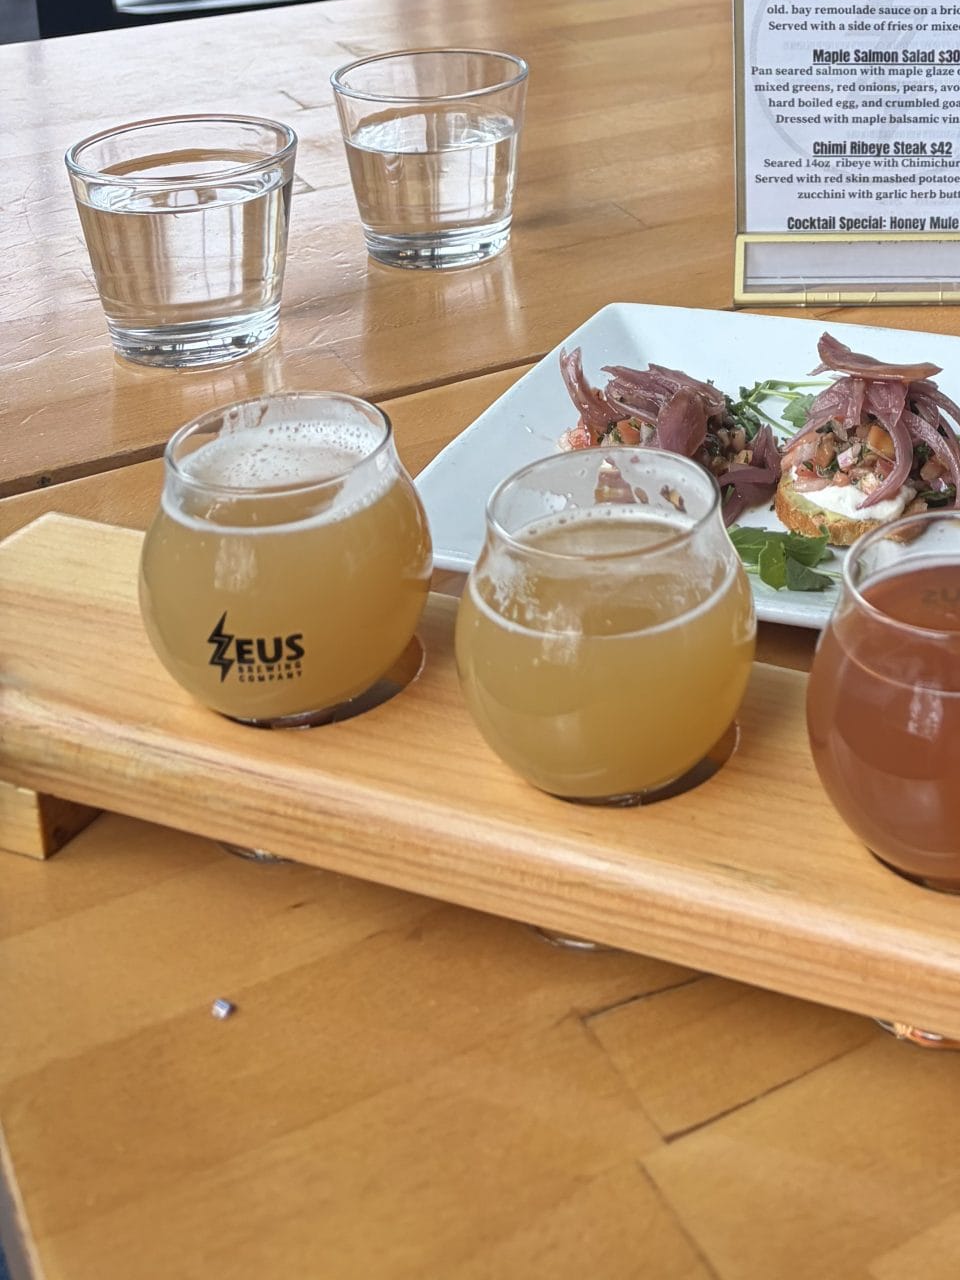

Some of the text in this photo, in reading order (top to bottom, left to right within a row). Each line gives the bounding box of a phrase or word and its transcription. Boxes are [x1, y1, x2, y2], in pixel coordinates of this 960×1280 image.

[766, 3, 789, 15] old.
[791, 3, 813, 18] bay
[814, 4, 877, 16] remoulade
[877, 6, 912, 16] sauce
[912, 7, 929, 16] on
[930, 7, 938, 16] a
[768, 20, 809, 32] Served
[809, 20, 837, 32] with
[838, 23, 846, 32] a
[847, 19, 872, 32] side
[872, 20, 887, 32] of
[887, 20, 914, 32] fries
[915, 23, 930, 32] or
[812, 48, 852, 65] Maple
[853, 48, 900, 64] Salmon
[901, 48, 936, 64] Salad
[751, 65, 774, 77] Pan
[775, 65, 814, 77] seared
[815, 65, 858, 77] salmon
[859, 65, 886, 77] with
[887, 65, 924, 79] maple
[925, 65, 956, 79] glaze
[754, 81, 791, 93] mixed
[791, 83, 835, 95] greens,
[836, 81, 857, 93] red
[857, 81, 901, 94] onions,
[902, 84, 939, 95] pears,
[767, 97, 796, 109] hard
[797, 97, 834, 109] boiled
[835, 99, 860, 111] egg,
[861, 97, 884, 109] and
[884, 97, 941, 109] crumbled
[775, 113, 822, 125] Dressed
[823, 113, 850, 125] with
[851, 113, 888, 127] maple
[888, 113, 941, 125] balsamic
[812, 140, 848, 157] Chimi
[850, 140, 890, 158] Ribeye
[892, 140, 928, 157] Steak
[929, 140, 954, 157] $42
[763, 157, 803, 169] Seared
[805, 158, 832, 169] 14oz
[835, 157, 872, 171] ribeye
[872, 157, 899, 169] with
[754, 173, 795, 185] Served
[795, 173, 823, 184] with
[823, 173, 844, 184] red
[845, 173, 871, 184] skin
[871, 173, 917, 185] mashed
[797, 188, 846, 200] zucchini
[847, 188, 874, 200] with
[875, 188, 909, 202] garlic
[909, 189, 938, 200] herb
[786, 215, 837, 231] Cocktail
[838, 215, 887, 233] Special:
[889, 215, 927, 232] Honey
[929, 215, 960, 231] Mule
[206, 609, 306, 684] ZEUS
[238, 661, 302, 673] BREWING
[238, 670, 303, 683] COMPANY
